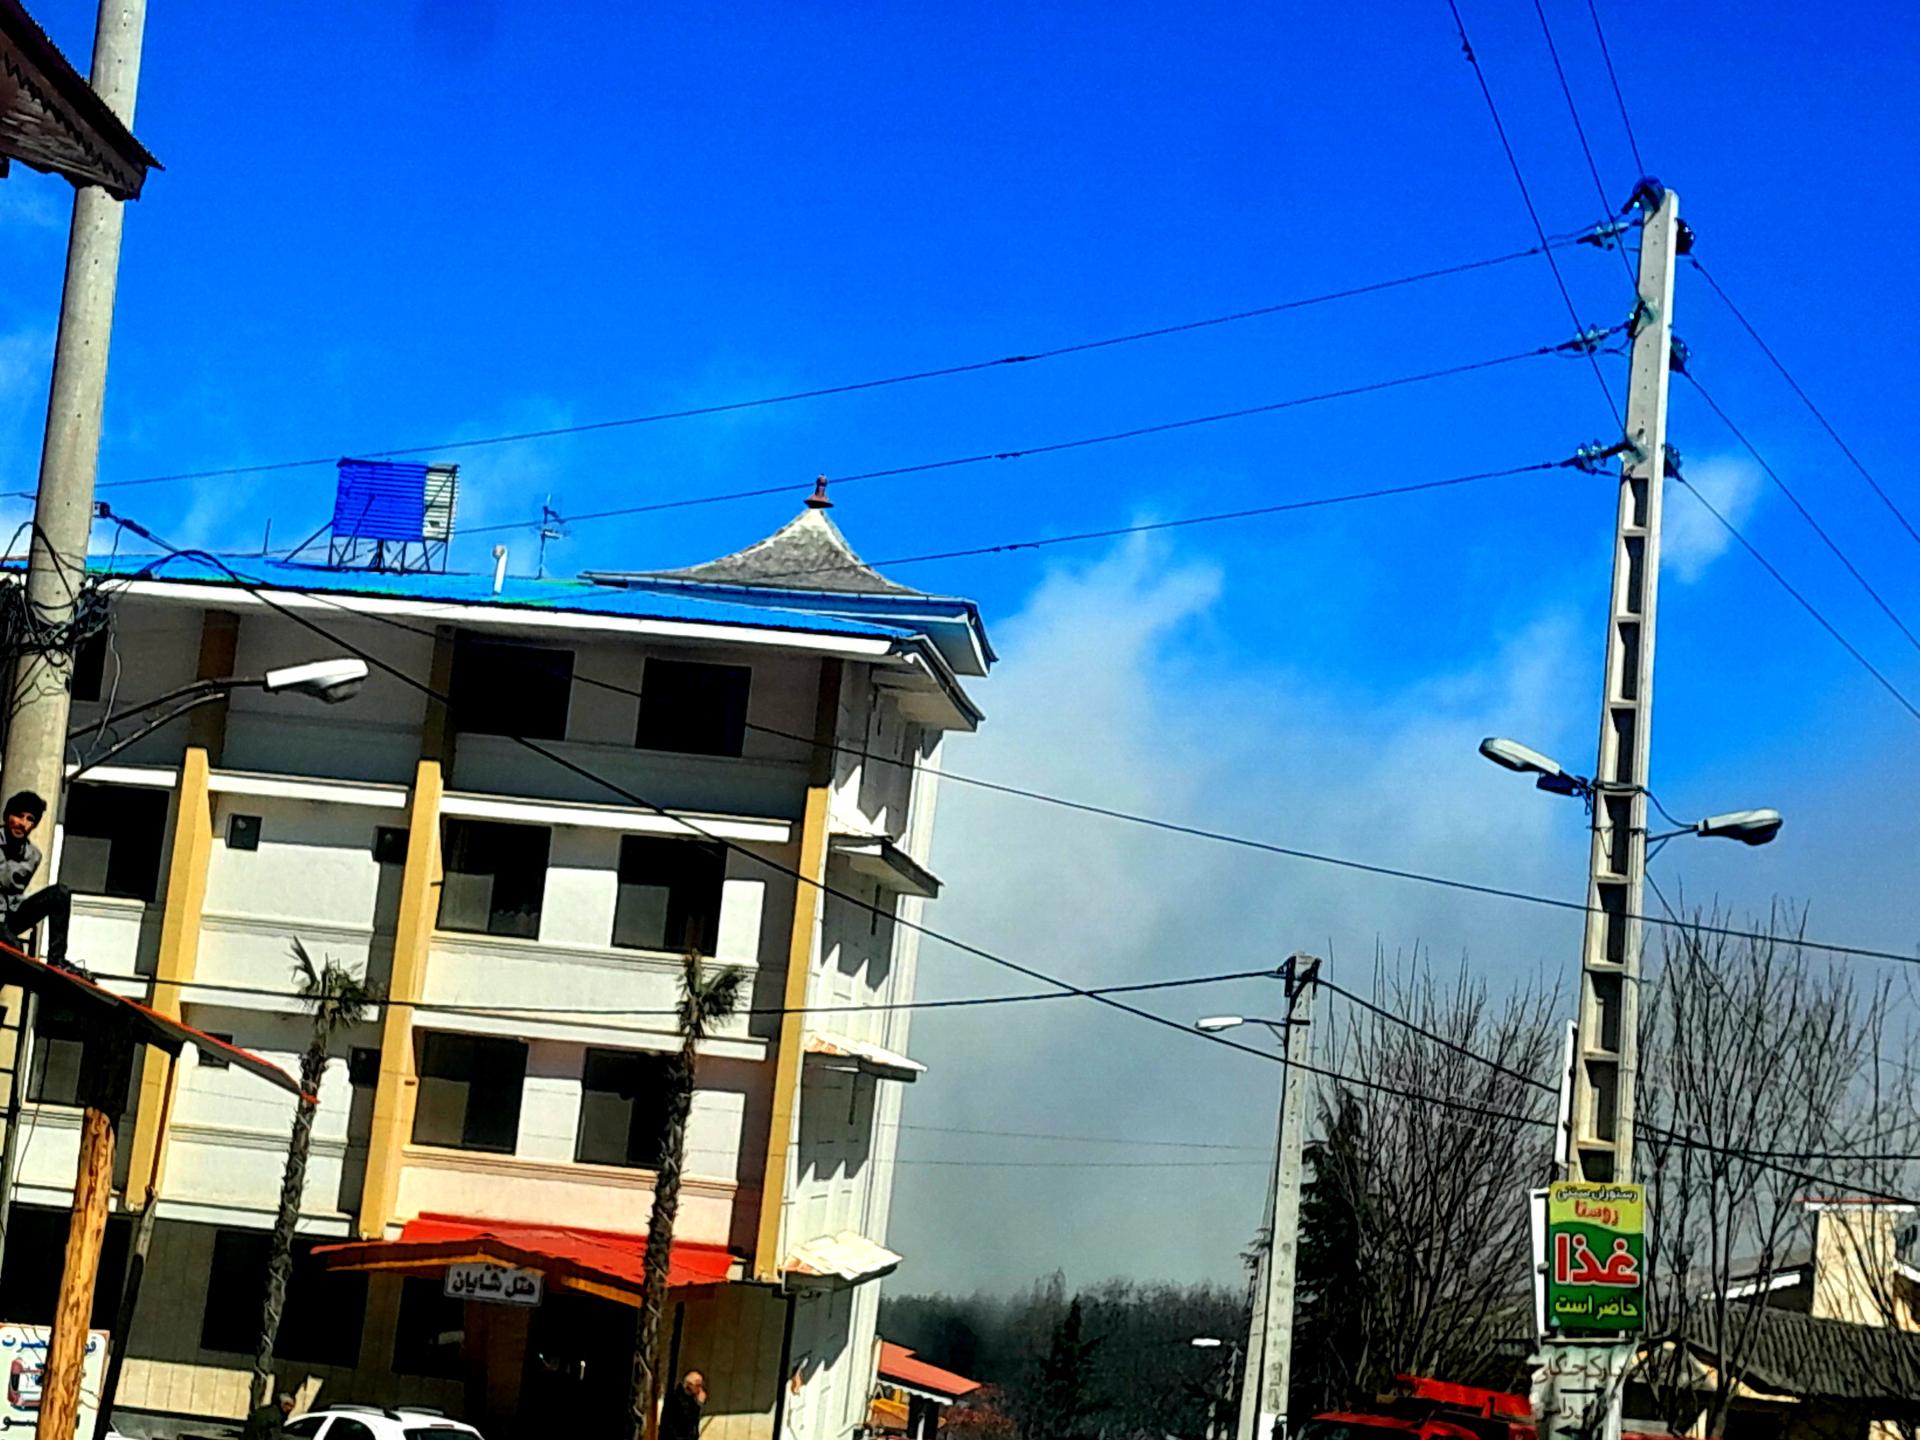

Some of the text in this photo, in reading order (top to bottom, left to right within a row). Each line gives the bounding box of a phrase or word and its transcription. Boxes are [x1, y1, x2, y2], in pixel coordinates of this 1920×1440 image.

[1575, 1200, 1619, 1226] روستا
[1555, 1233, 1640, 1286] غذا
[504, 1275, 536, 1298] هتل
[1555, 1295, 1638, 1320] حاضر است
